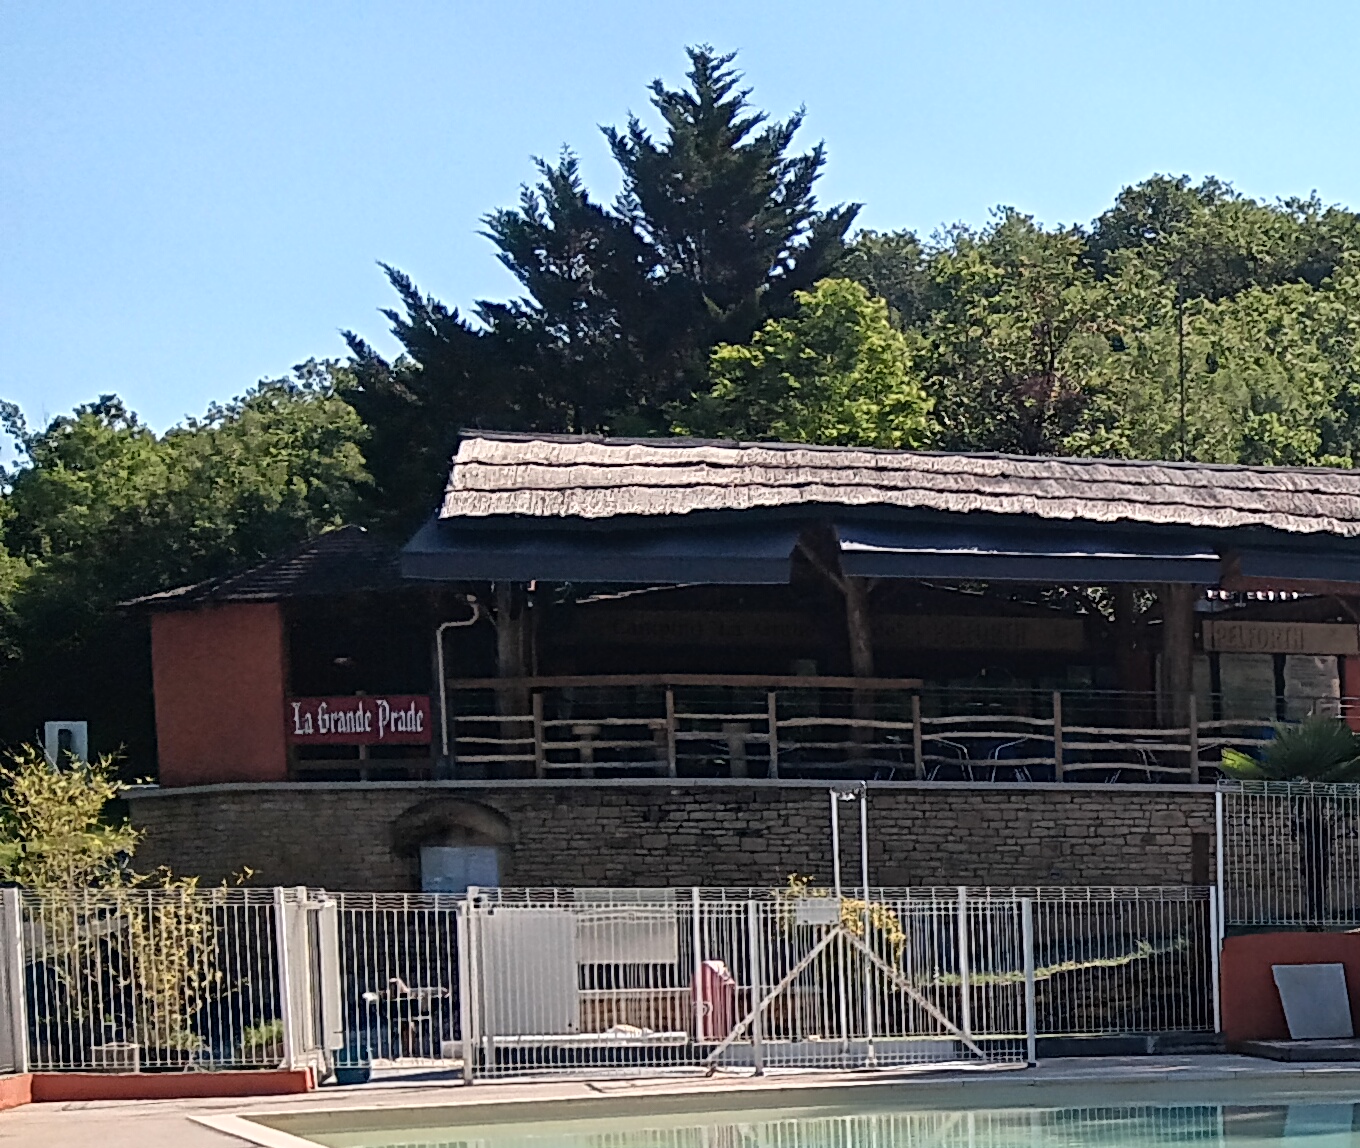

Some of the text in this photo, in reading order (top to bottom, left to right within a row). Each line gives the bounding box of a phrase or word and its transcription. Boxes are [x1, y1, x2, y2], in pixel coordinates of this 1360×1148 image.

[1214, 625, 1304, 650] PELFORTH
[290, 699, 424, 740] La Grande Prade
